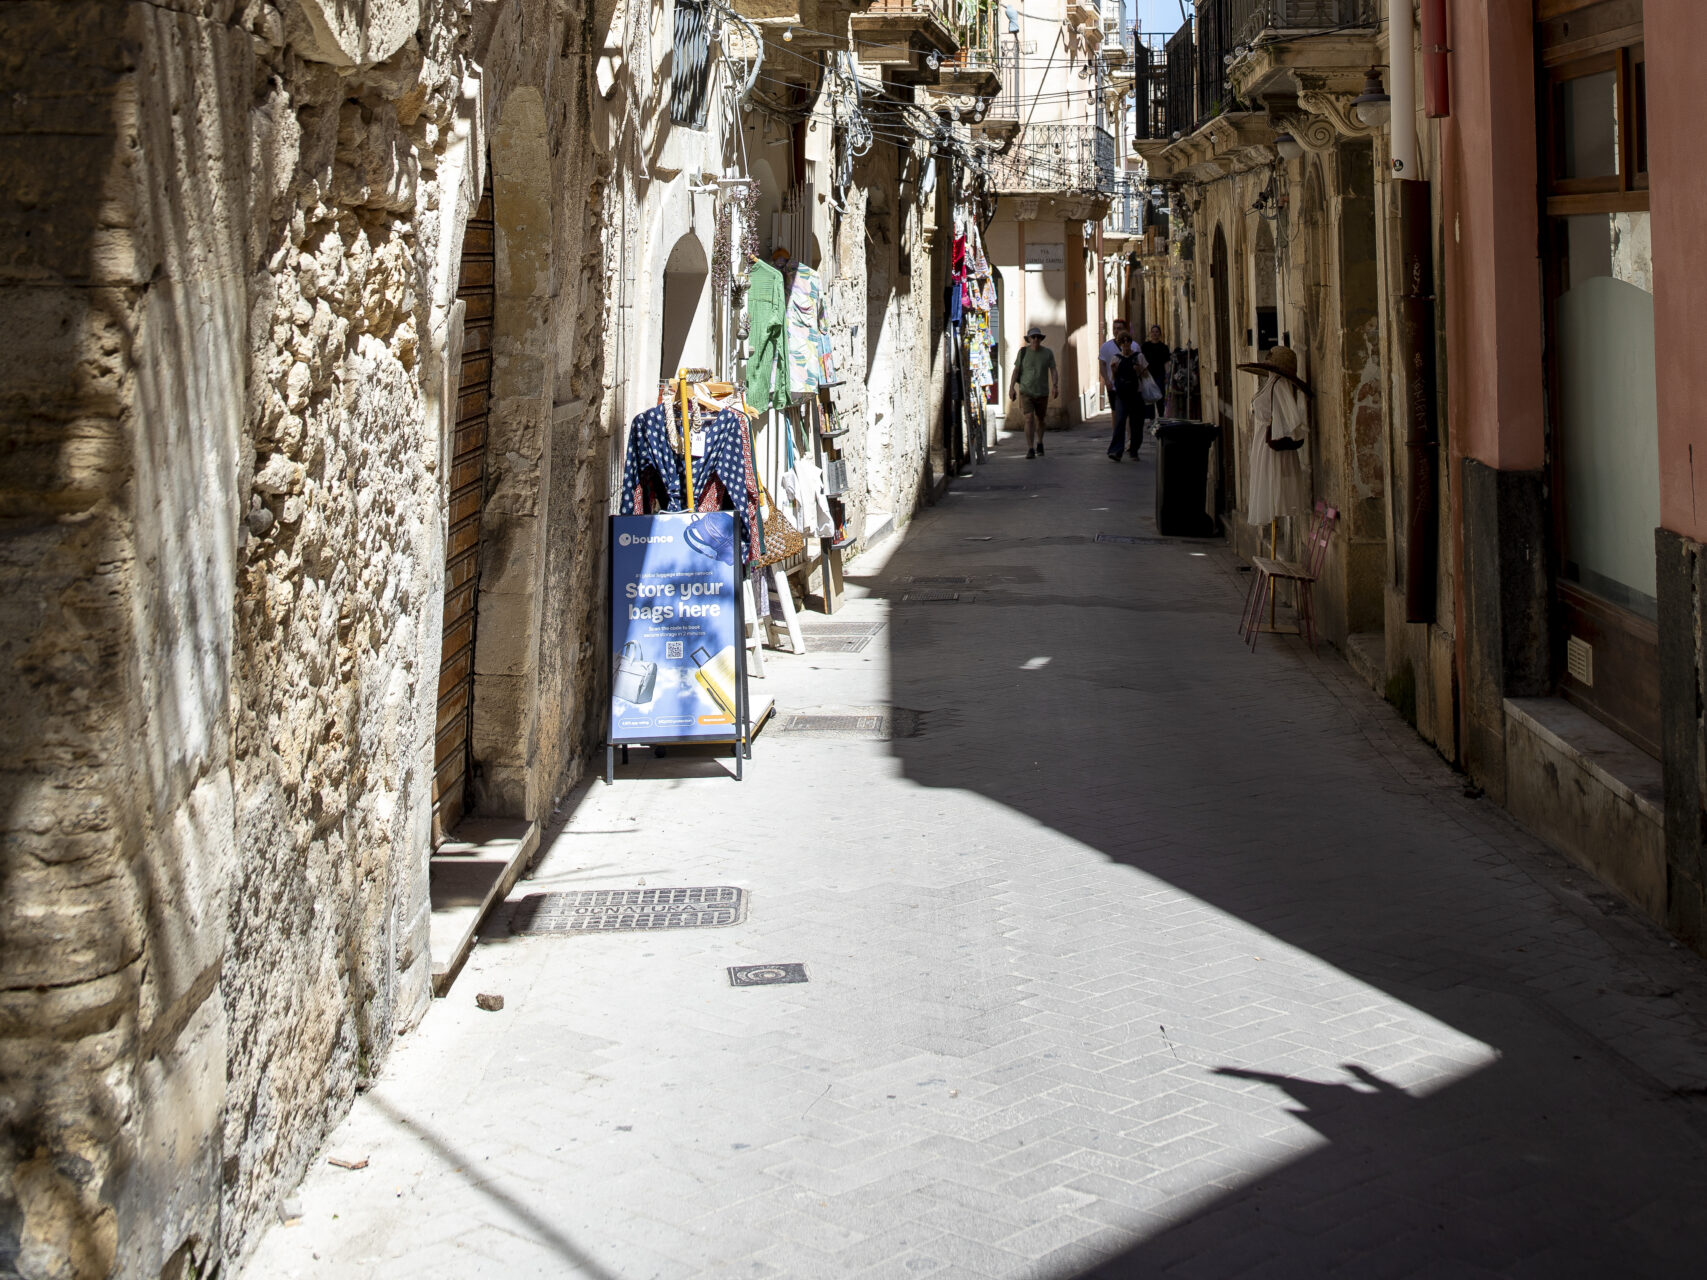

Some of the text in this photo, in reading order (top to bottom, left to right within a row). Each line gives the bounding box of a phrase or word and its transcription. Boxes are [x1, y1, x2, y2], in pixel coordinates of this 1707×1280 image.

[632, 535, 674, 544] bounce
[625, 582, 723, 600] Store your
[628, 602, 720, 623] bags here
